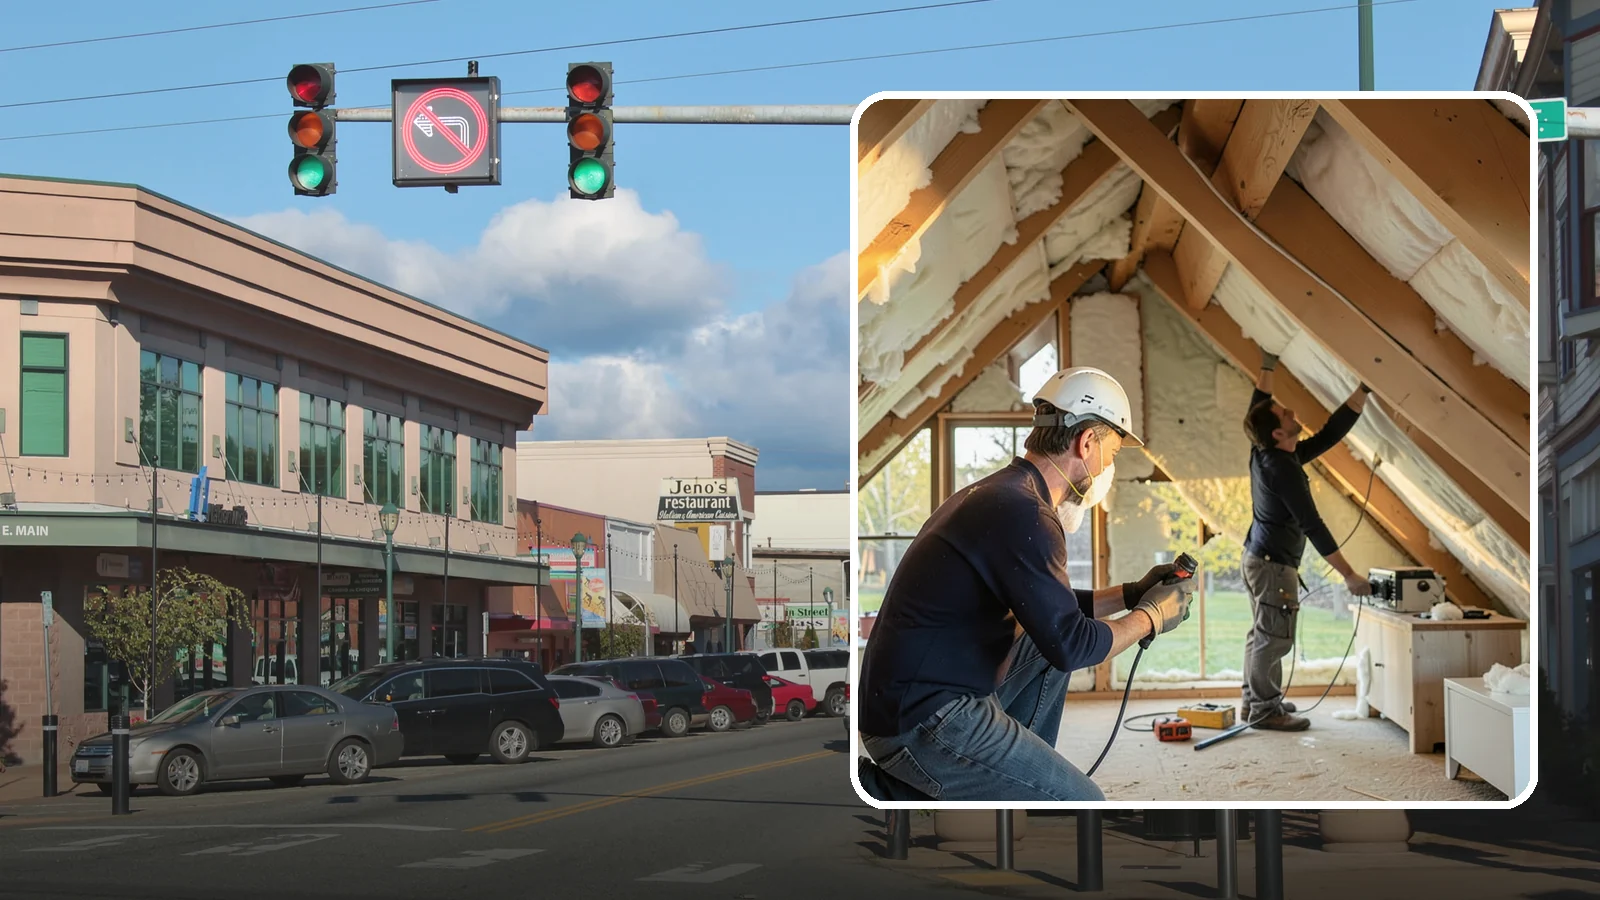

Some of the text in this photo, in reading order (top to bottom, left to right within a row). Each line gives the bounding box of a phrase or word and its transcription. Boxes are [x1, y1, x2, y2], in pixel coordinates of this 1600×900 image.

[670, 480, 727, 494] Jeno's
[665, 496, 731, 509] restaurant
[659, 510, 681, 519] Italian
[686, 510, 714, 519] American
[715, 510, 737, 519] Cuisine
[2, 525, 48, 536] E. MAIN
[797, 608, 828, 616] Street
